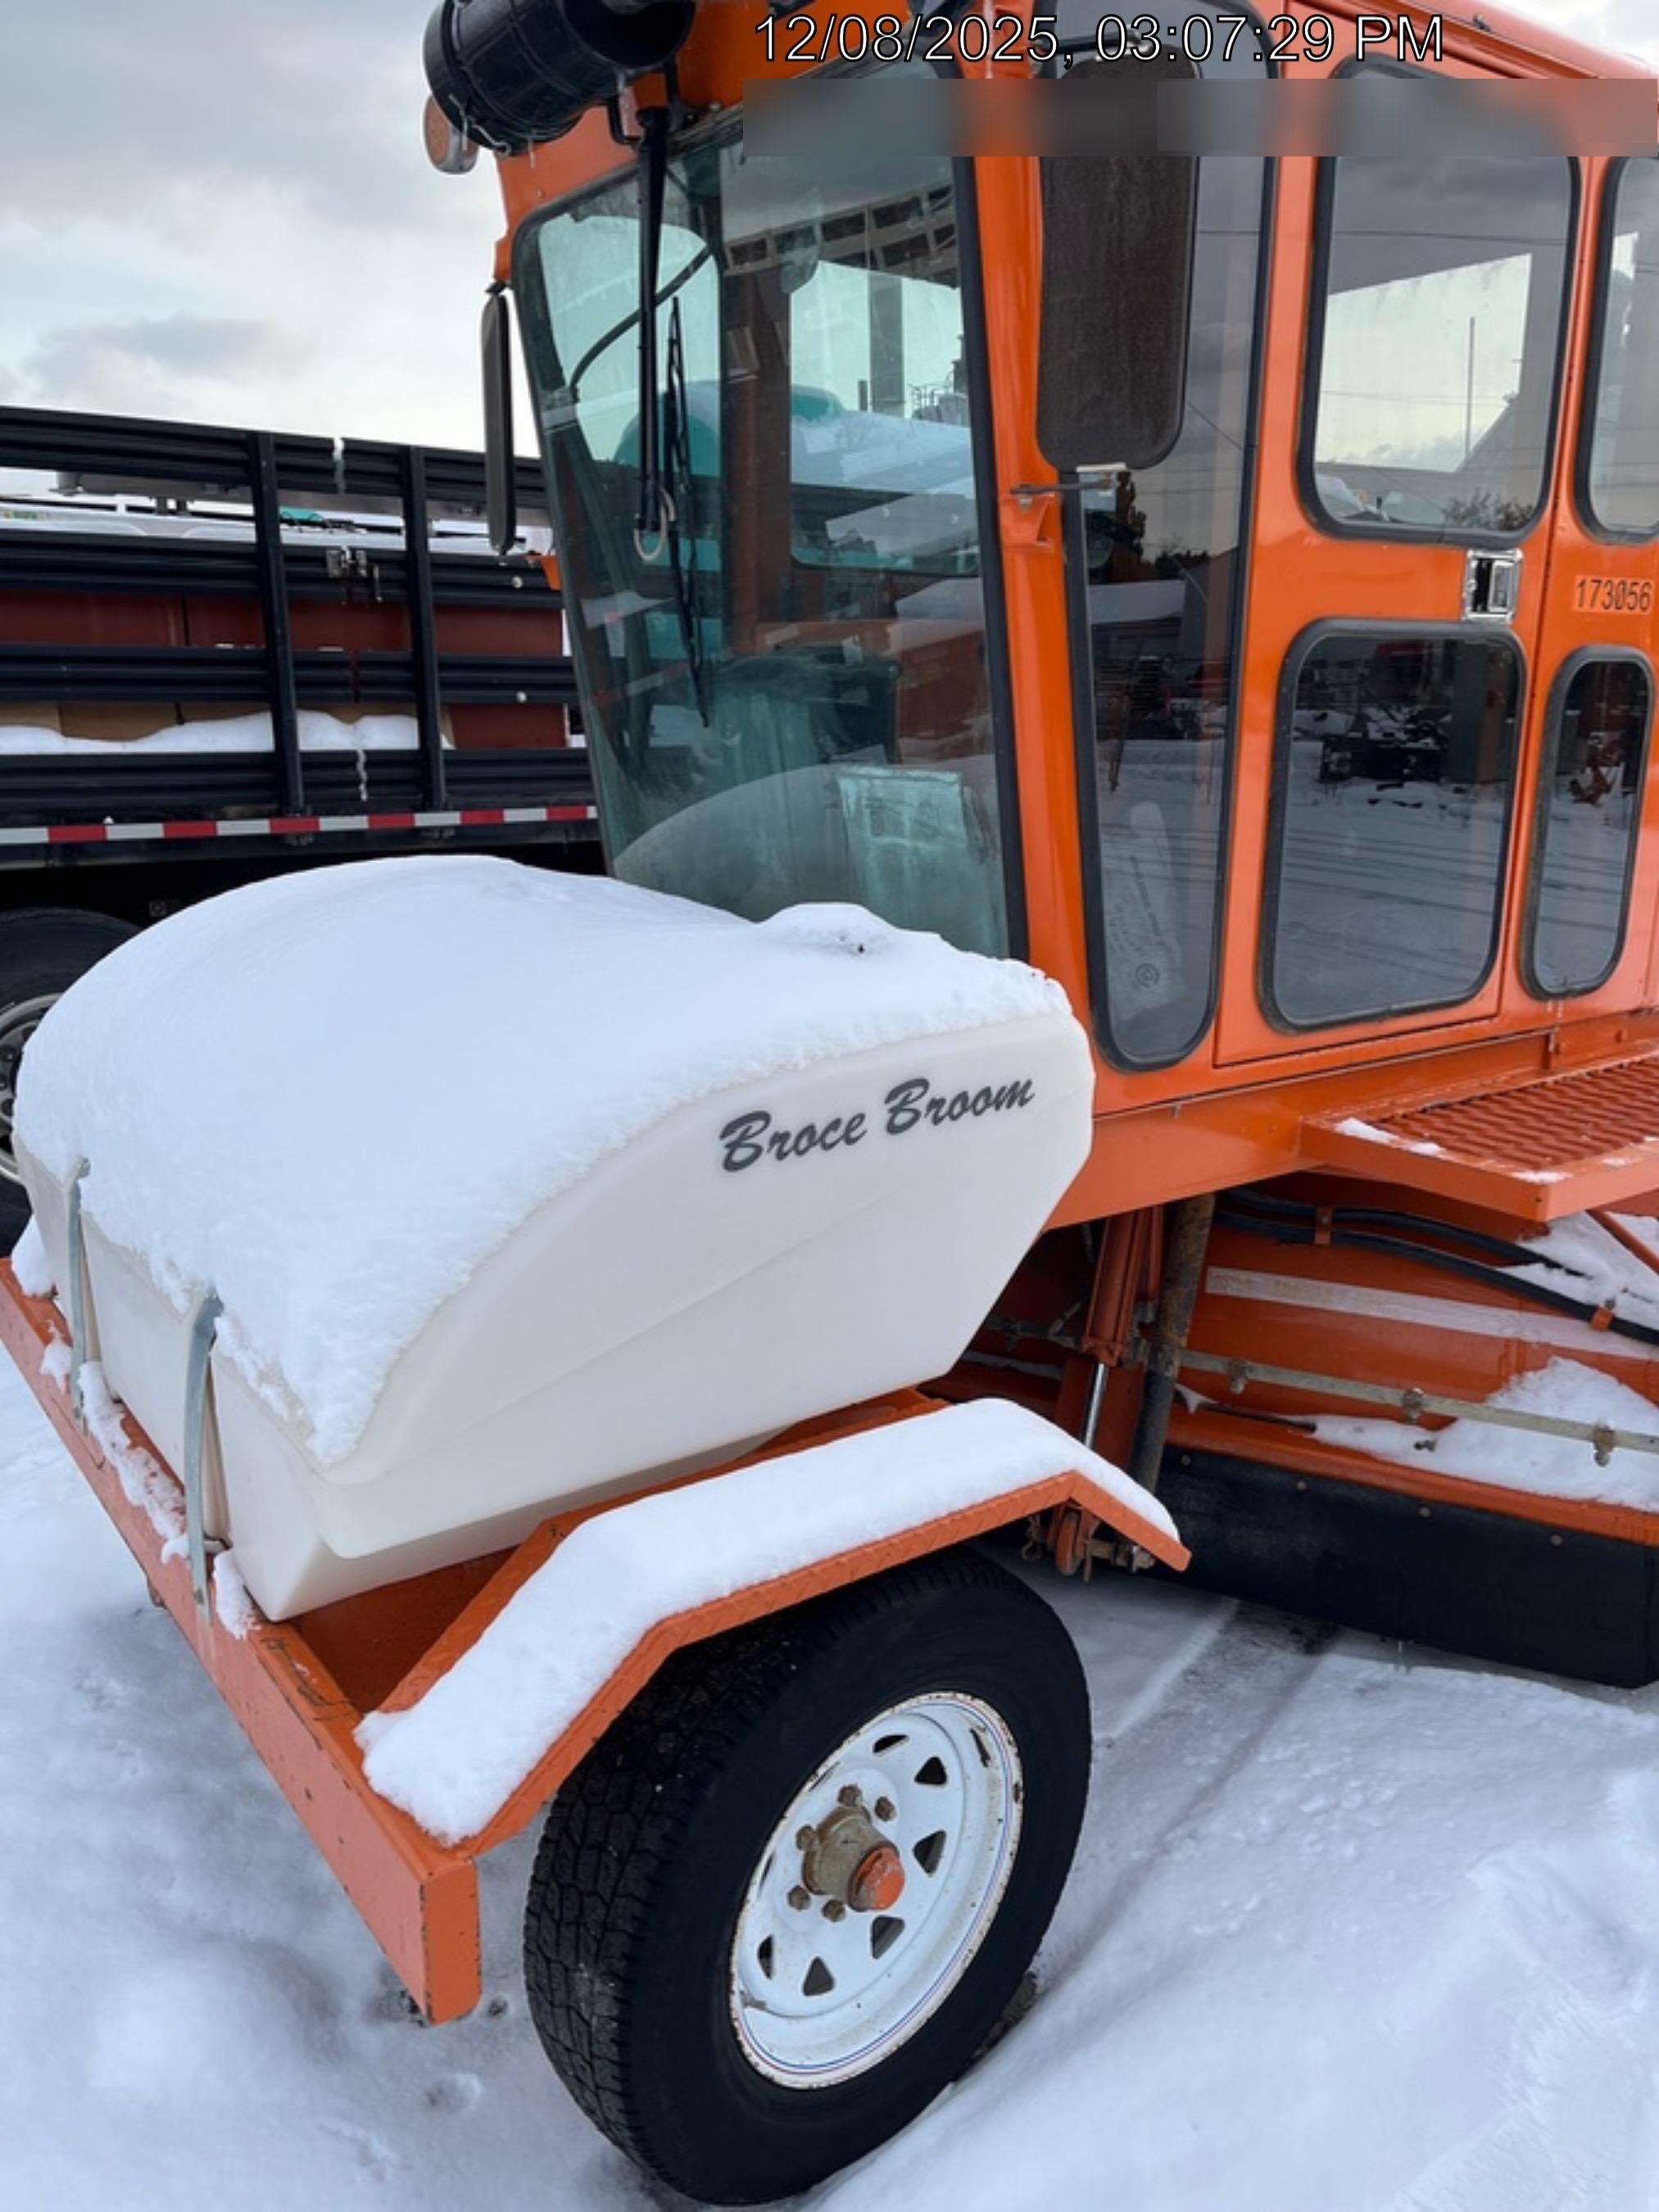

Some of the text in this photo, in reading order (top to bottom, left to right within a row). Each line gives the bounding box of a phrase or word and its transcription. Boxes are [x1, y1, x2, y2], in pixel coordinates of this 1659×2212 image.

[1576, 578, 1652, 613] 173056
[718, 1077, 1036, 1172] Broce Broom
